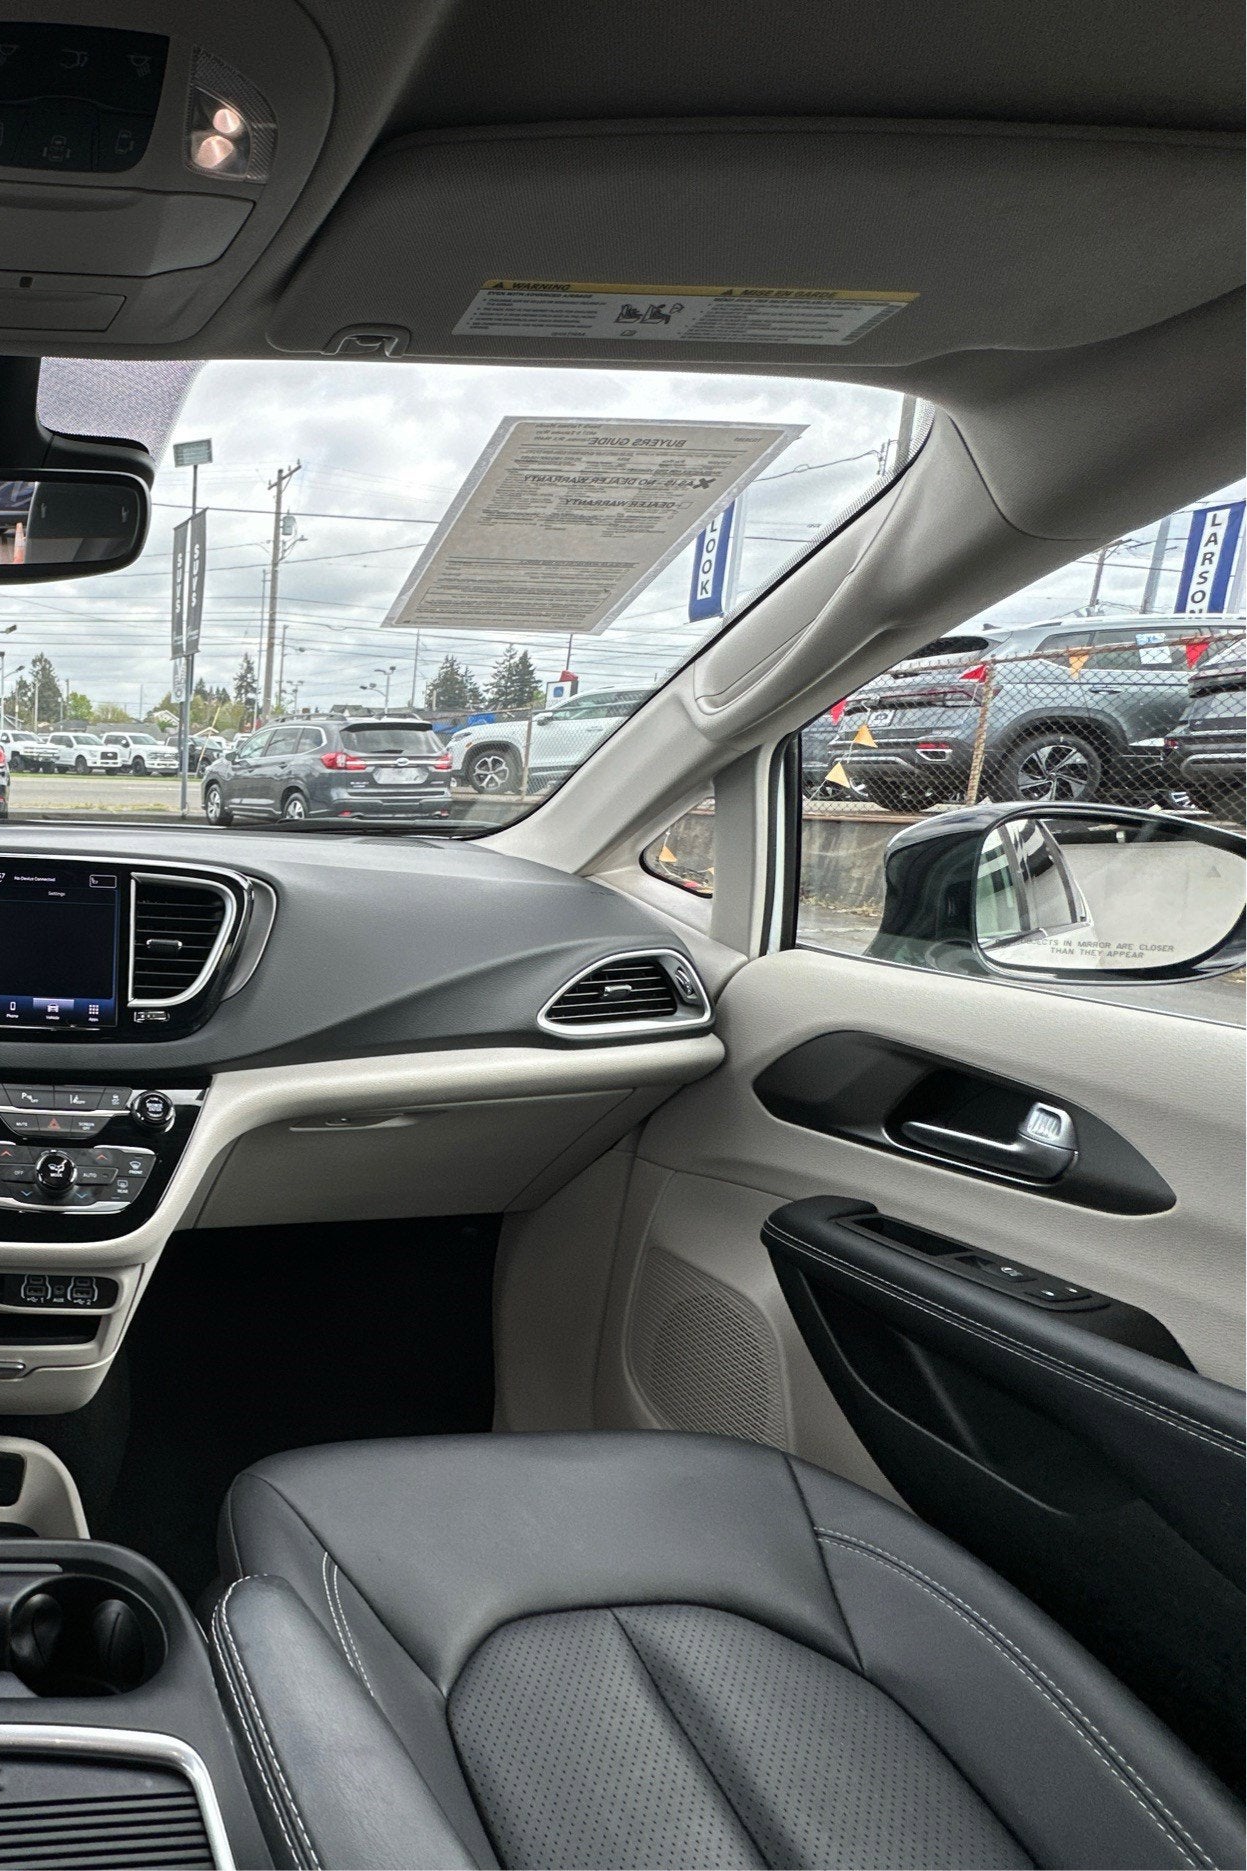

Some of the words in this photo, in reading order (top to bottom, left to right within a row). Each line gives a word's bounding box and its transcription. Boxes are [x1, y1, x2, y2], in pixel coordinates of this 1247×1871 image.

[700, 520, 717, 596] LOOK
[1189, 513, 1222, 613] LARSO
[1063, 939, 1072, 947] IN
[1077, 941, 1112, 949] MIRROR
[1139, 943, 1176, 952] CLOSER
[1079, 949, 1103, 957] THEY
[1106, 950, 1145, 958] APPEAR
